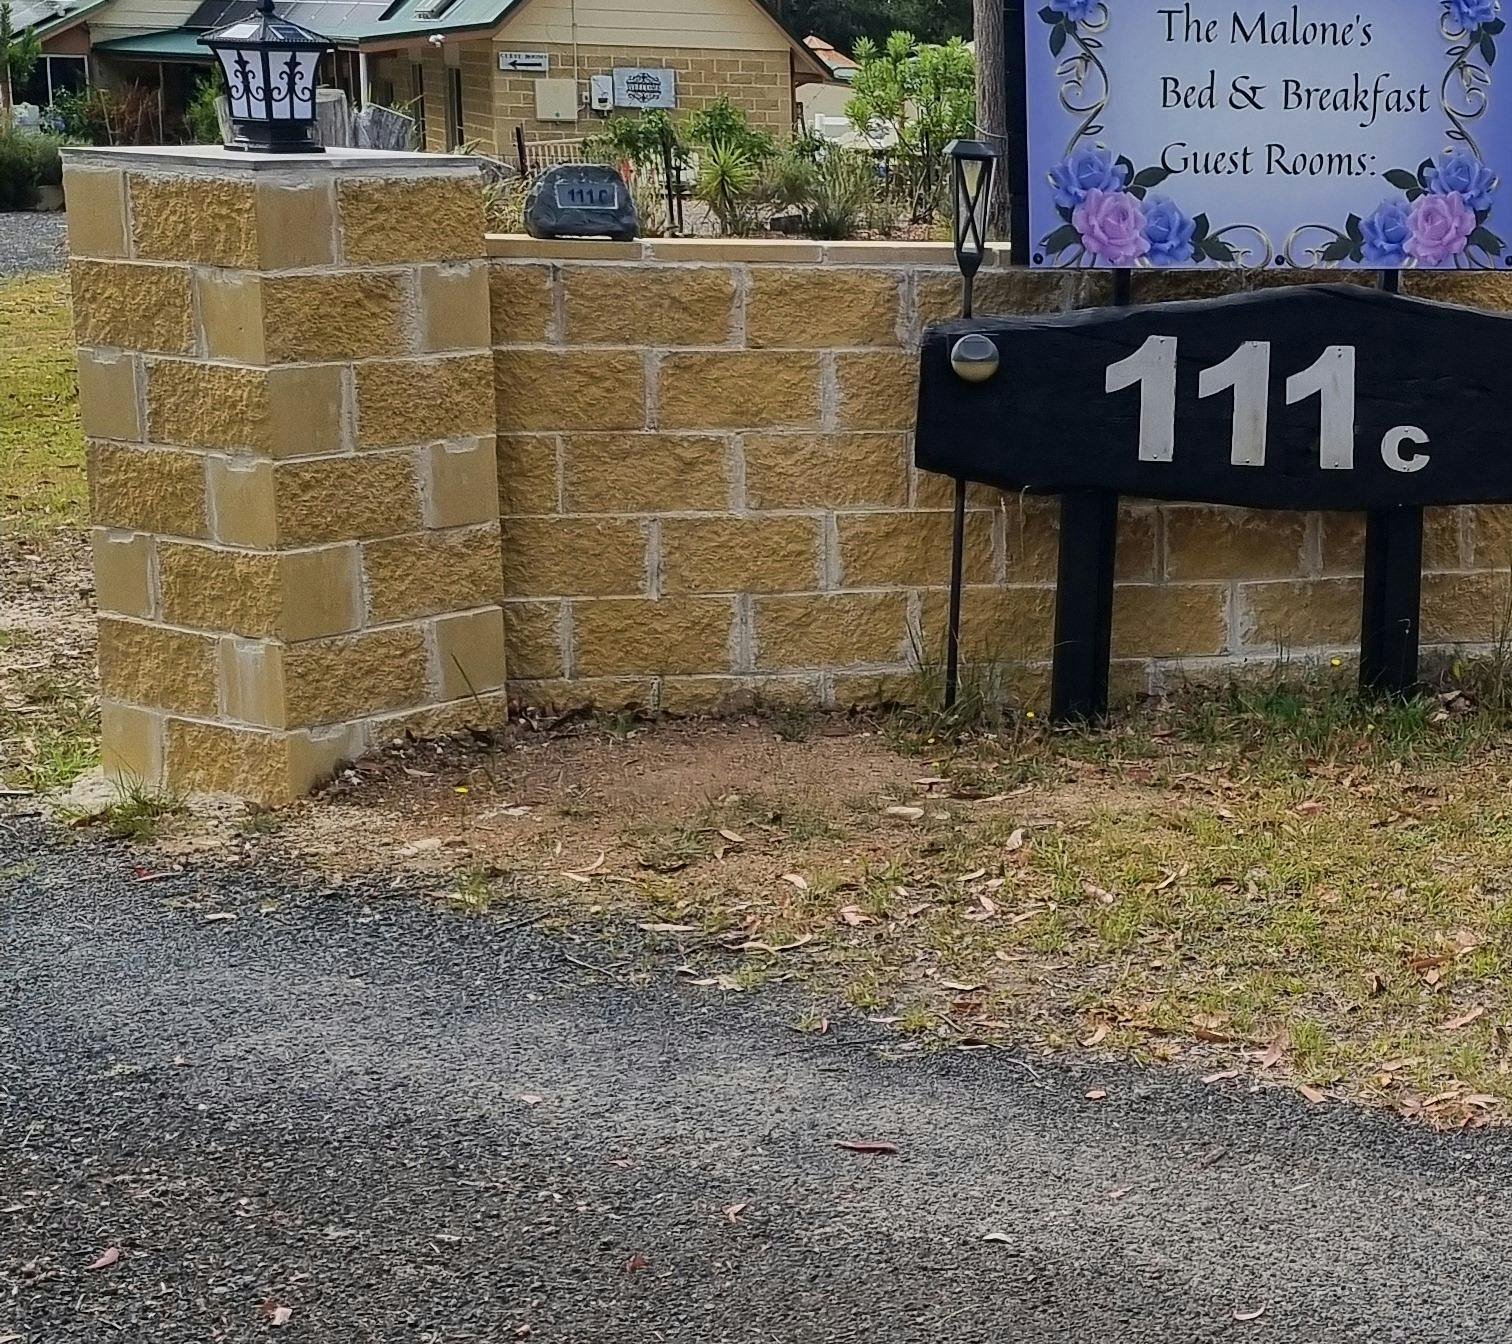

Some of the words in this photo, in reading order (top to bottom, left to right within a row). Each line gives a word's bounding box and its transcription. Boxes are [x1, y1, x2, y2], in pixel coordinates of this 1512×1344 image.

[1157, 2, 1218, 43] The
[1231, 5, 1373, 46] Malone's
[1160, 70, 1215, 109] Bed
[1229, 75, 1266, 110] &
[1282, 73, 1431, 127] Breakfast
[1160, 142, 1254, 175] Guest
[1265, 143, 1377, 176] Rooms:
